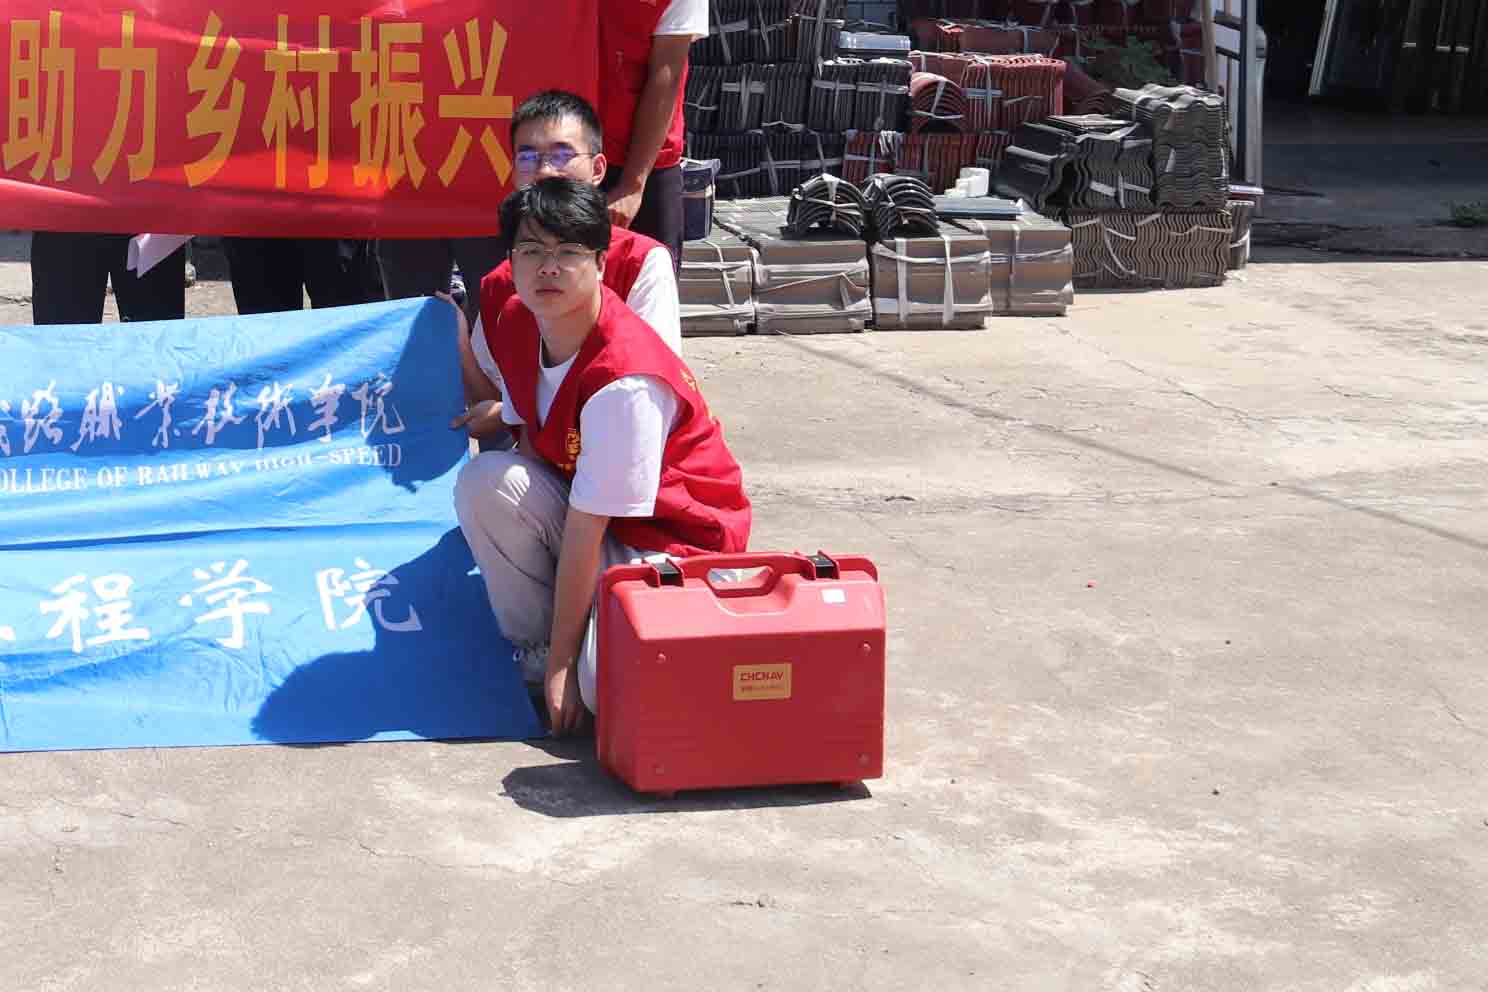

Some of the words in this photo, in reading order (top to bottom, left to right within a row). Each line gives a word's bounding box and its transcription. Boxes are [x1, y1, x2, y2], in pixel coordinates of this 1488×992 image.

[1, 10, 513, 190] 助力乡村振兴
[96, 466, 128, 489] OF
[135, 461, 244, 485] RAILWAY
